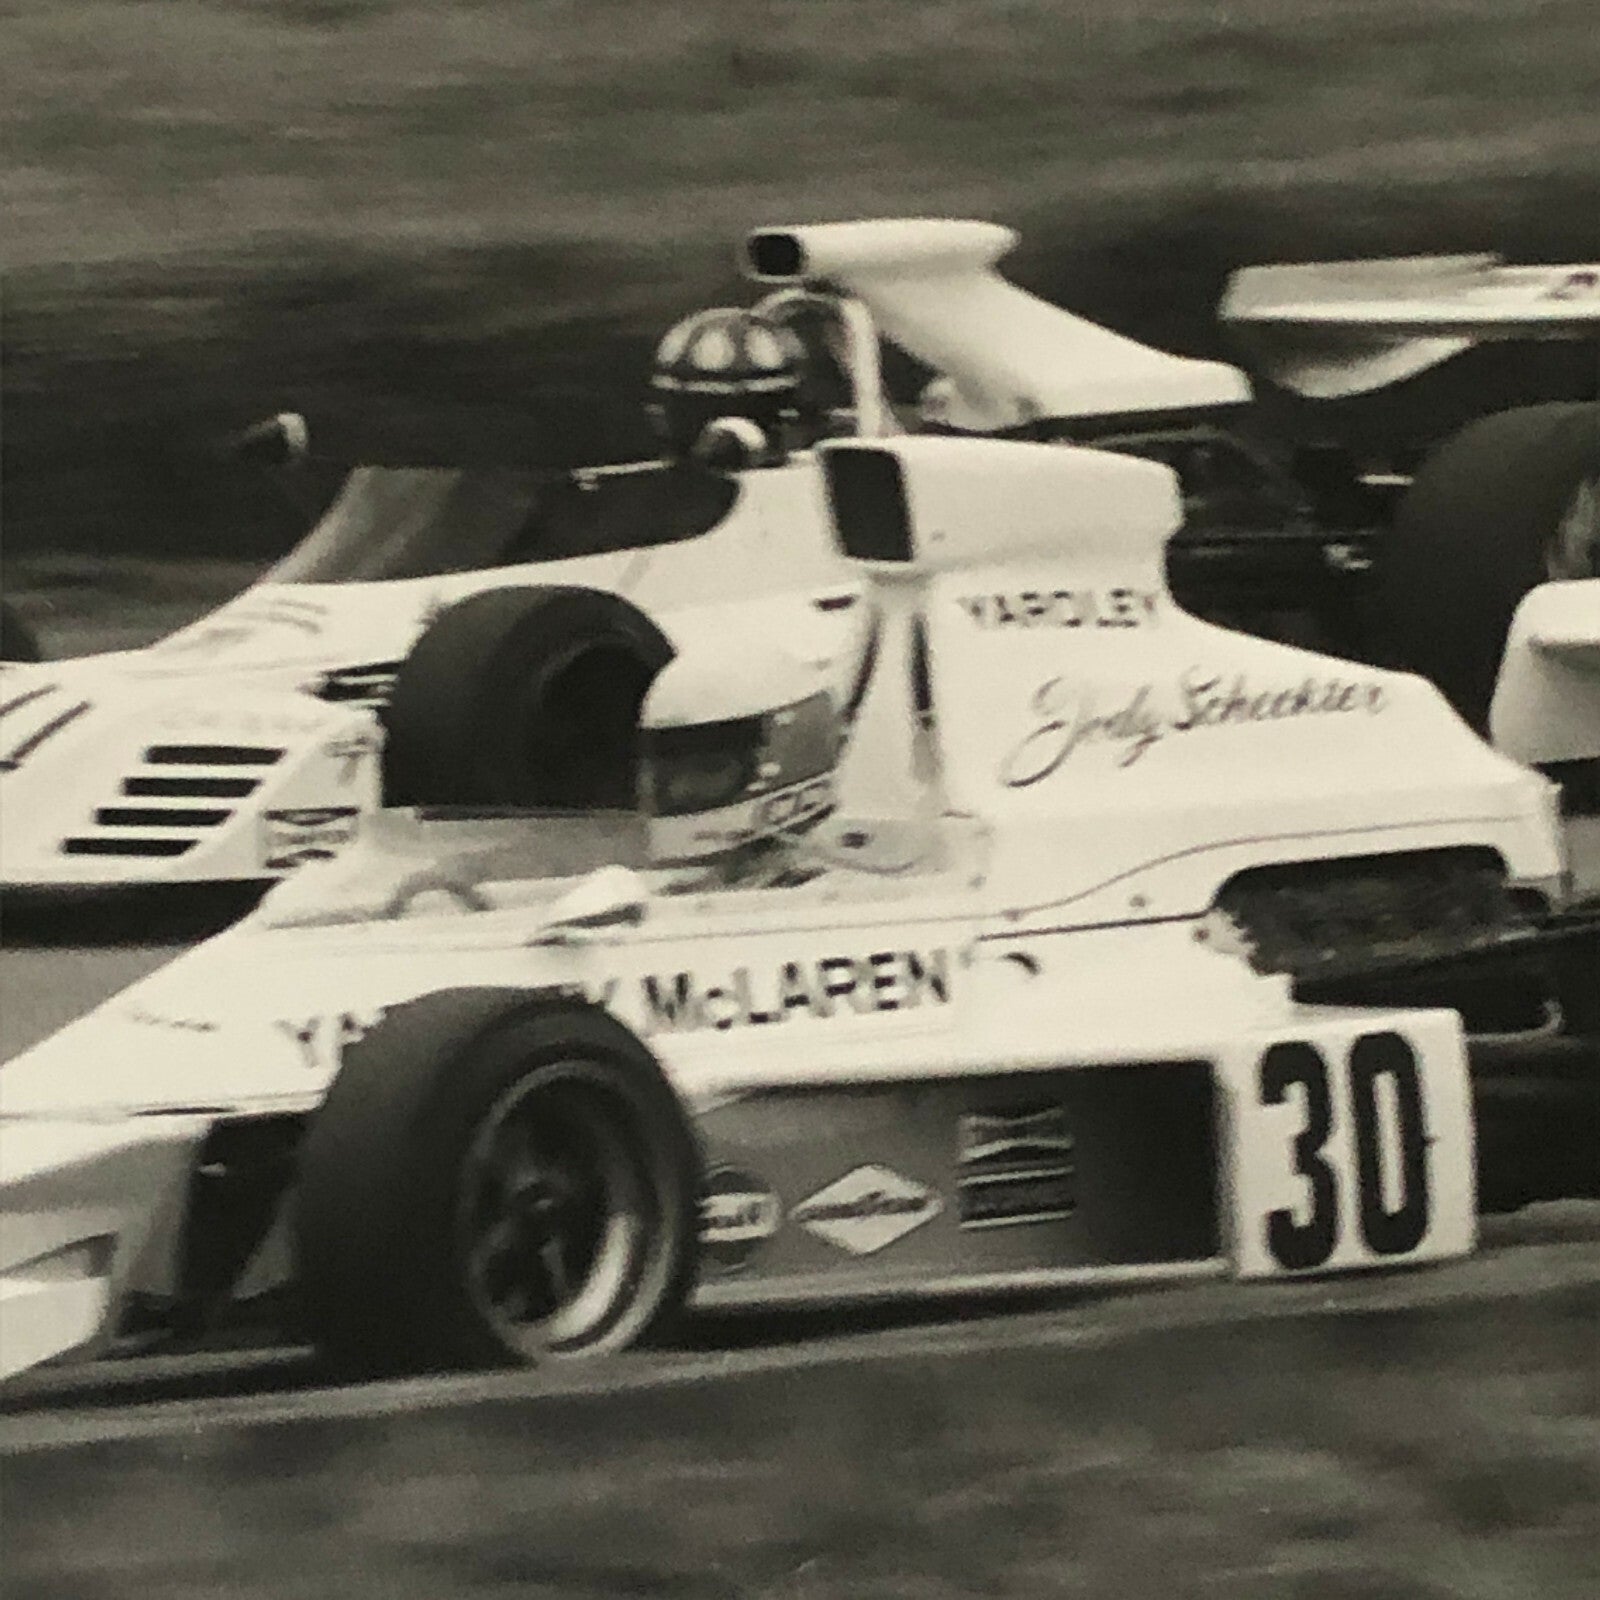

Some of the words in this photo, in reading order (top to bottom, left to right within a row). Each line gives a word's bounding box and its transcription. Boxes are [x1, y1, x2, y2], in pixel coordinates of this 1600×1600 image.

[956, 588, 1160, 630] YARDLEY
[640, 949, 949, 1034] McLAREN
[1261, 1031, 1428, 1270] 30
